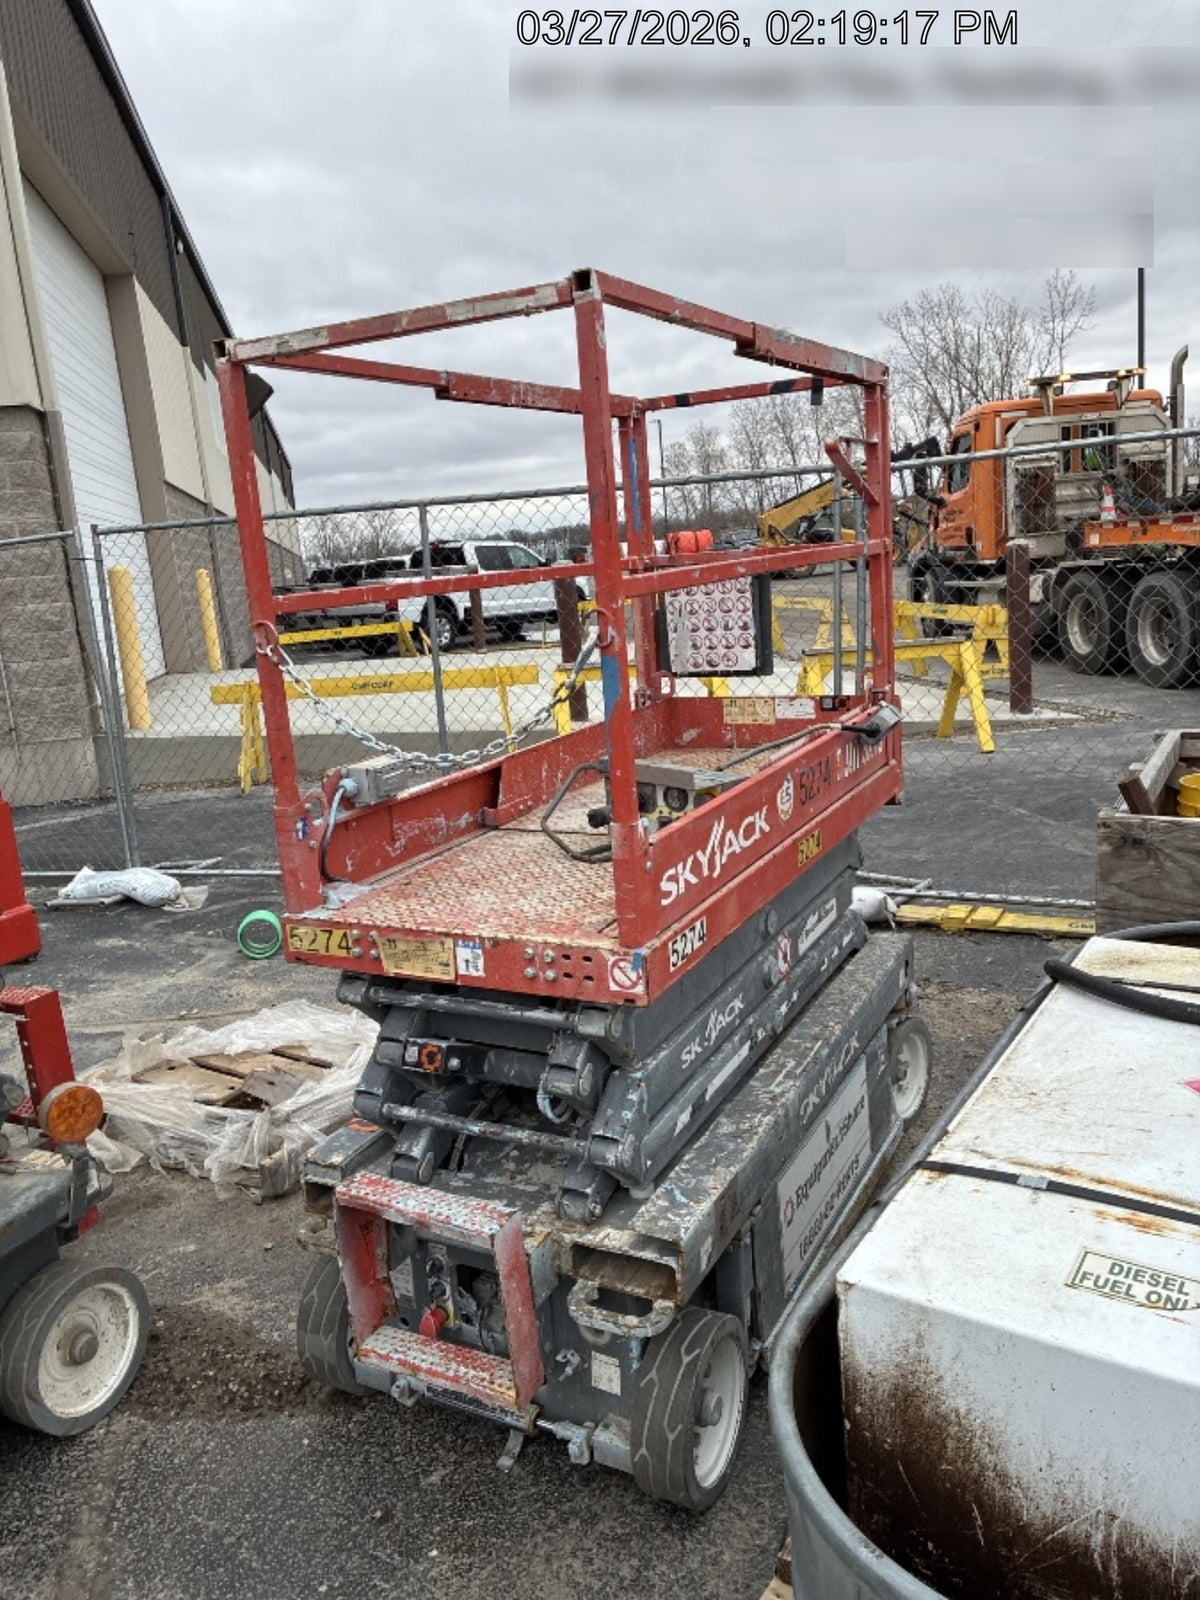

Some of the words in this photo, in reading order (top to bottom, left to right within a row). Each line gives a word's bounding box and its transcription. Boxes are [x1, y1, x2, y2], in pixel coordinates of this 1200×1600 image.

[659, 805, 771, 906] SKYJACK
[289, 926, 352, 955] 5274
[671, 920, 706, 968] 5274
[1079, 1270, 1137, 1299] FUEL
[1145, 1290, 1200, 1310] ON
[1108, 1261, 1190, 1297] DIESEL
